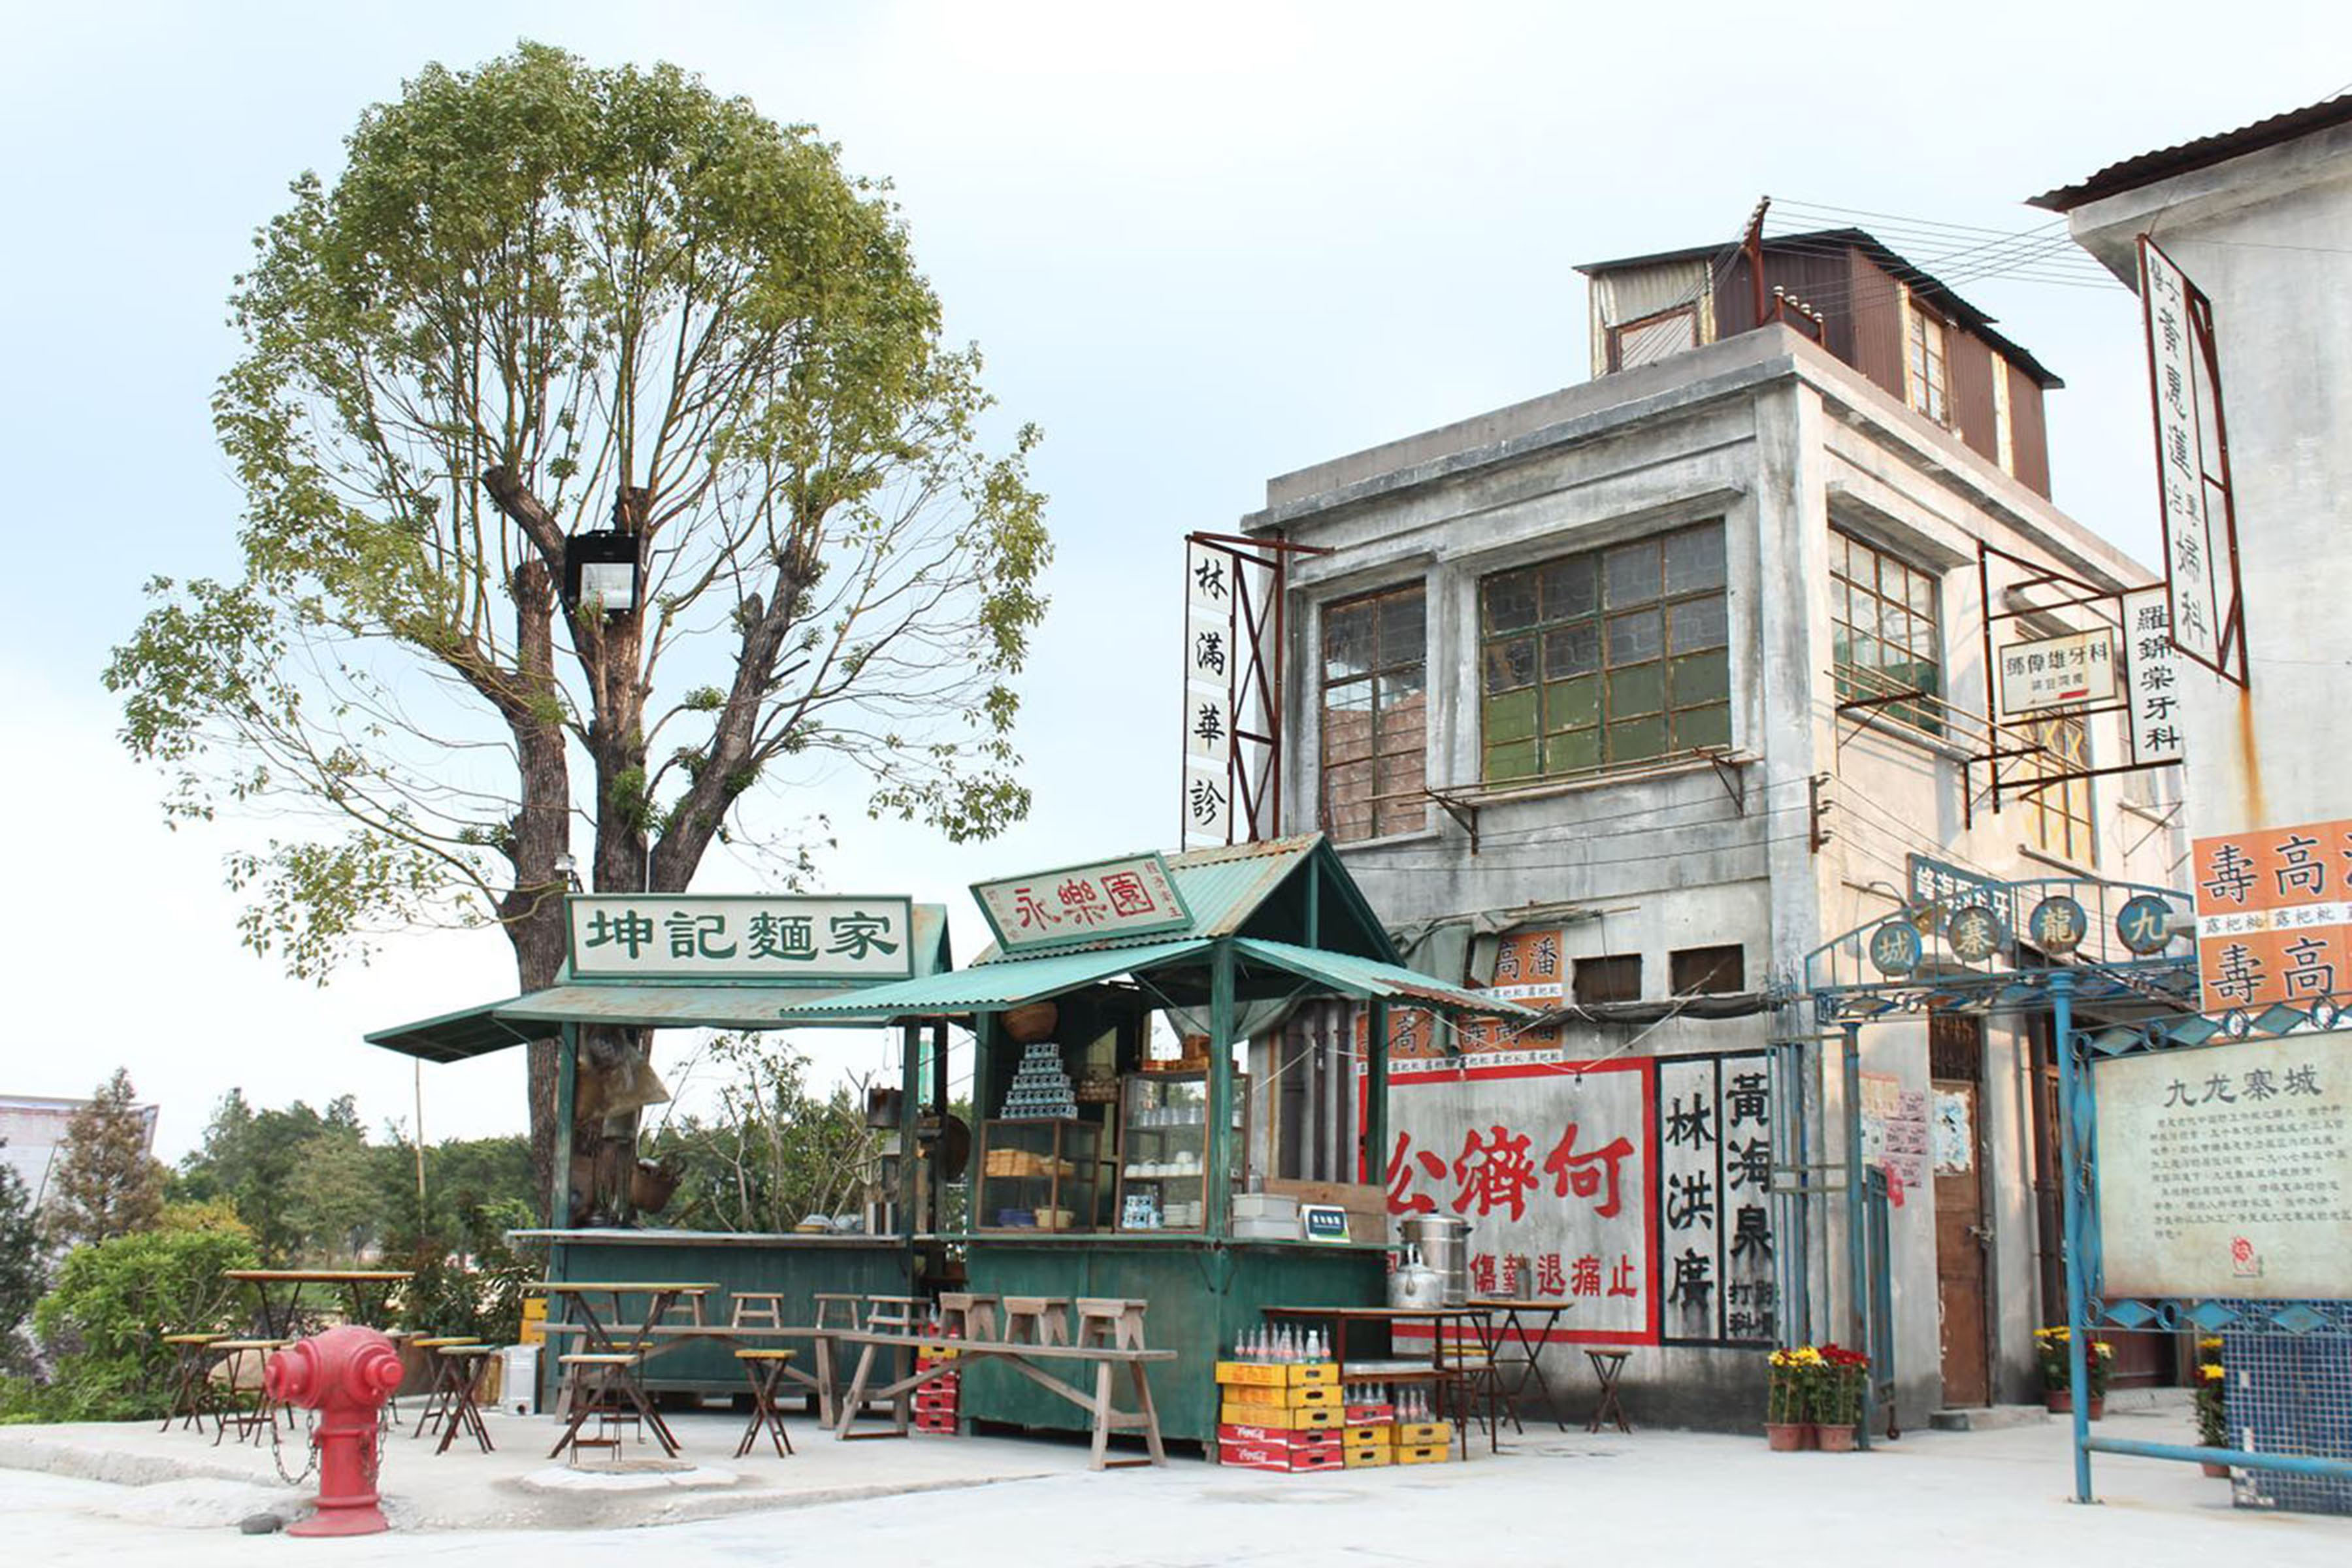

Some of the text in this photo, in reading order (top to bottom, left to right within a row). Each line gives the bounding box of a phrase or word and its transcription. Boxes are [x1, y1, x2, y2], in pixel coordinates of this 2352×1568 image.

[1189, 557, 1230, 826] 林滿華診
[1014, 871, 1156, 931] 永樂園
[585, 910, 898, 961] 坤記麵家
[2163, 1064, 2323, 1109] 九龙寨城
